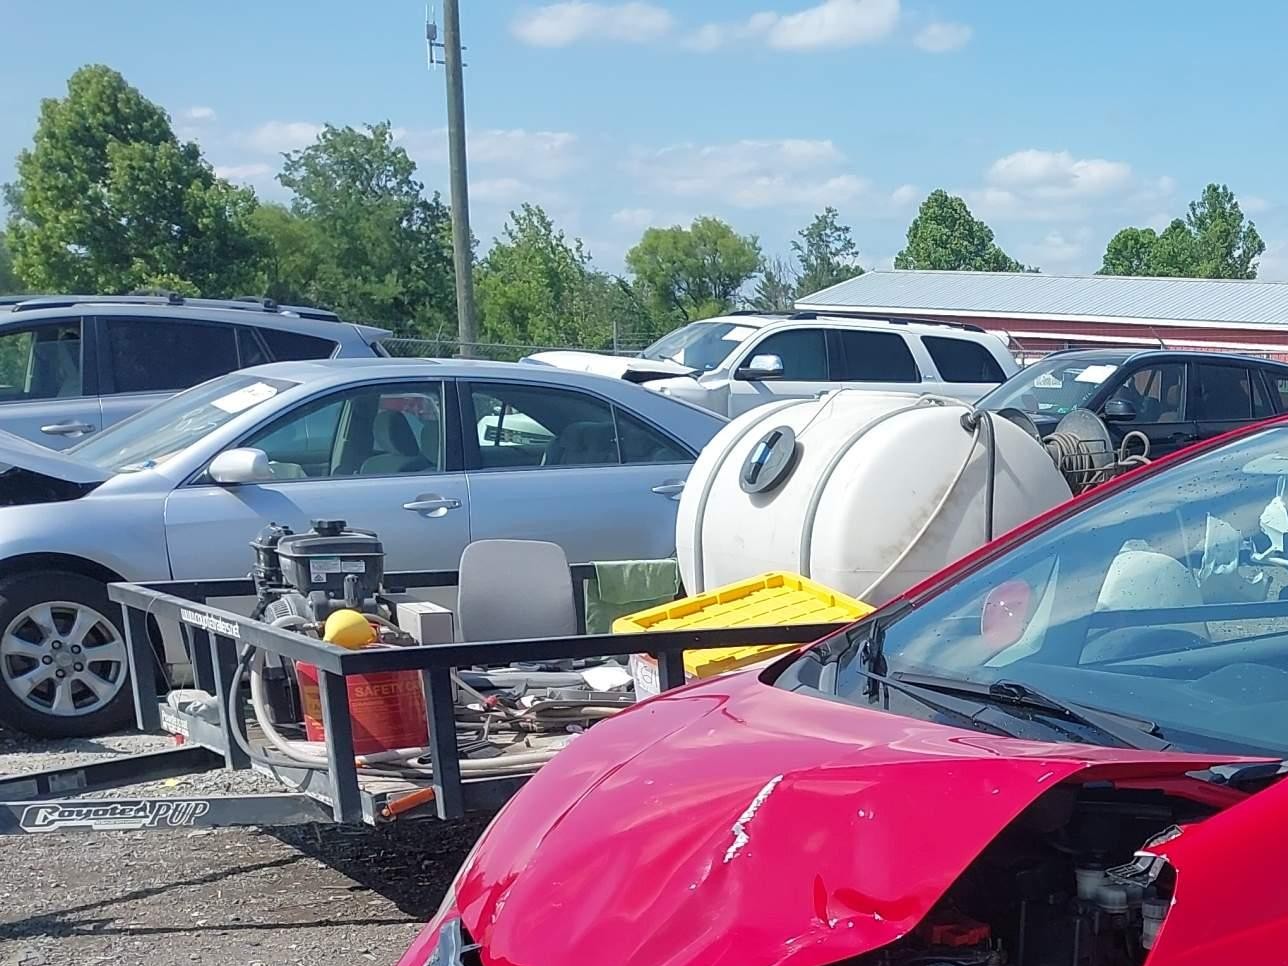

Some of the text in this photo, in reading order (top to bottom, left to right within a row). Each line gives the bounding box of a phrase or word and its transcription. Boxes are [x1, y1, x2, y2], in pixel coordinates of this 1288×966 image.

[354, 682, 404, 698] SAFETY
[20, 800, 210, 833] Coyote PUP
